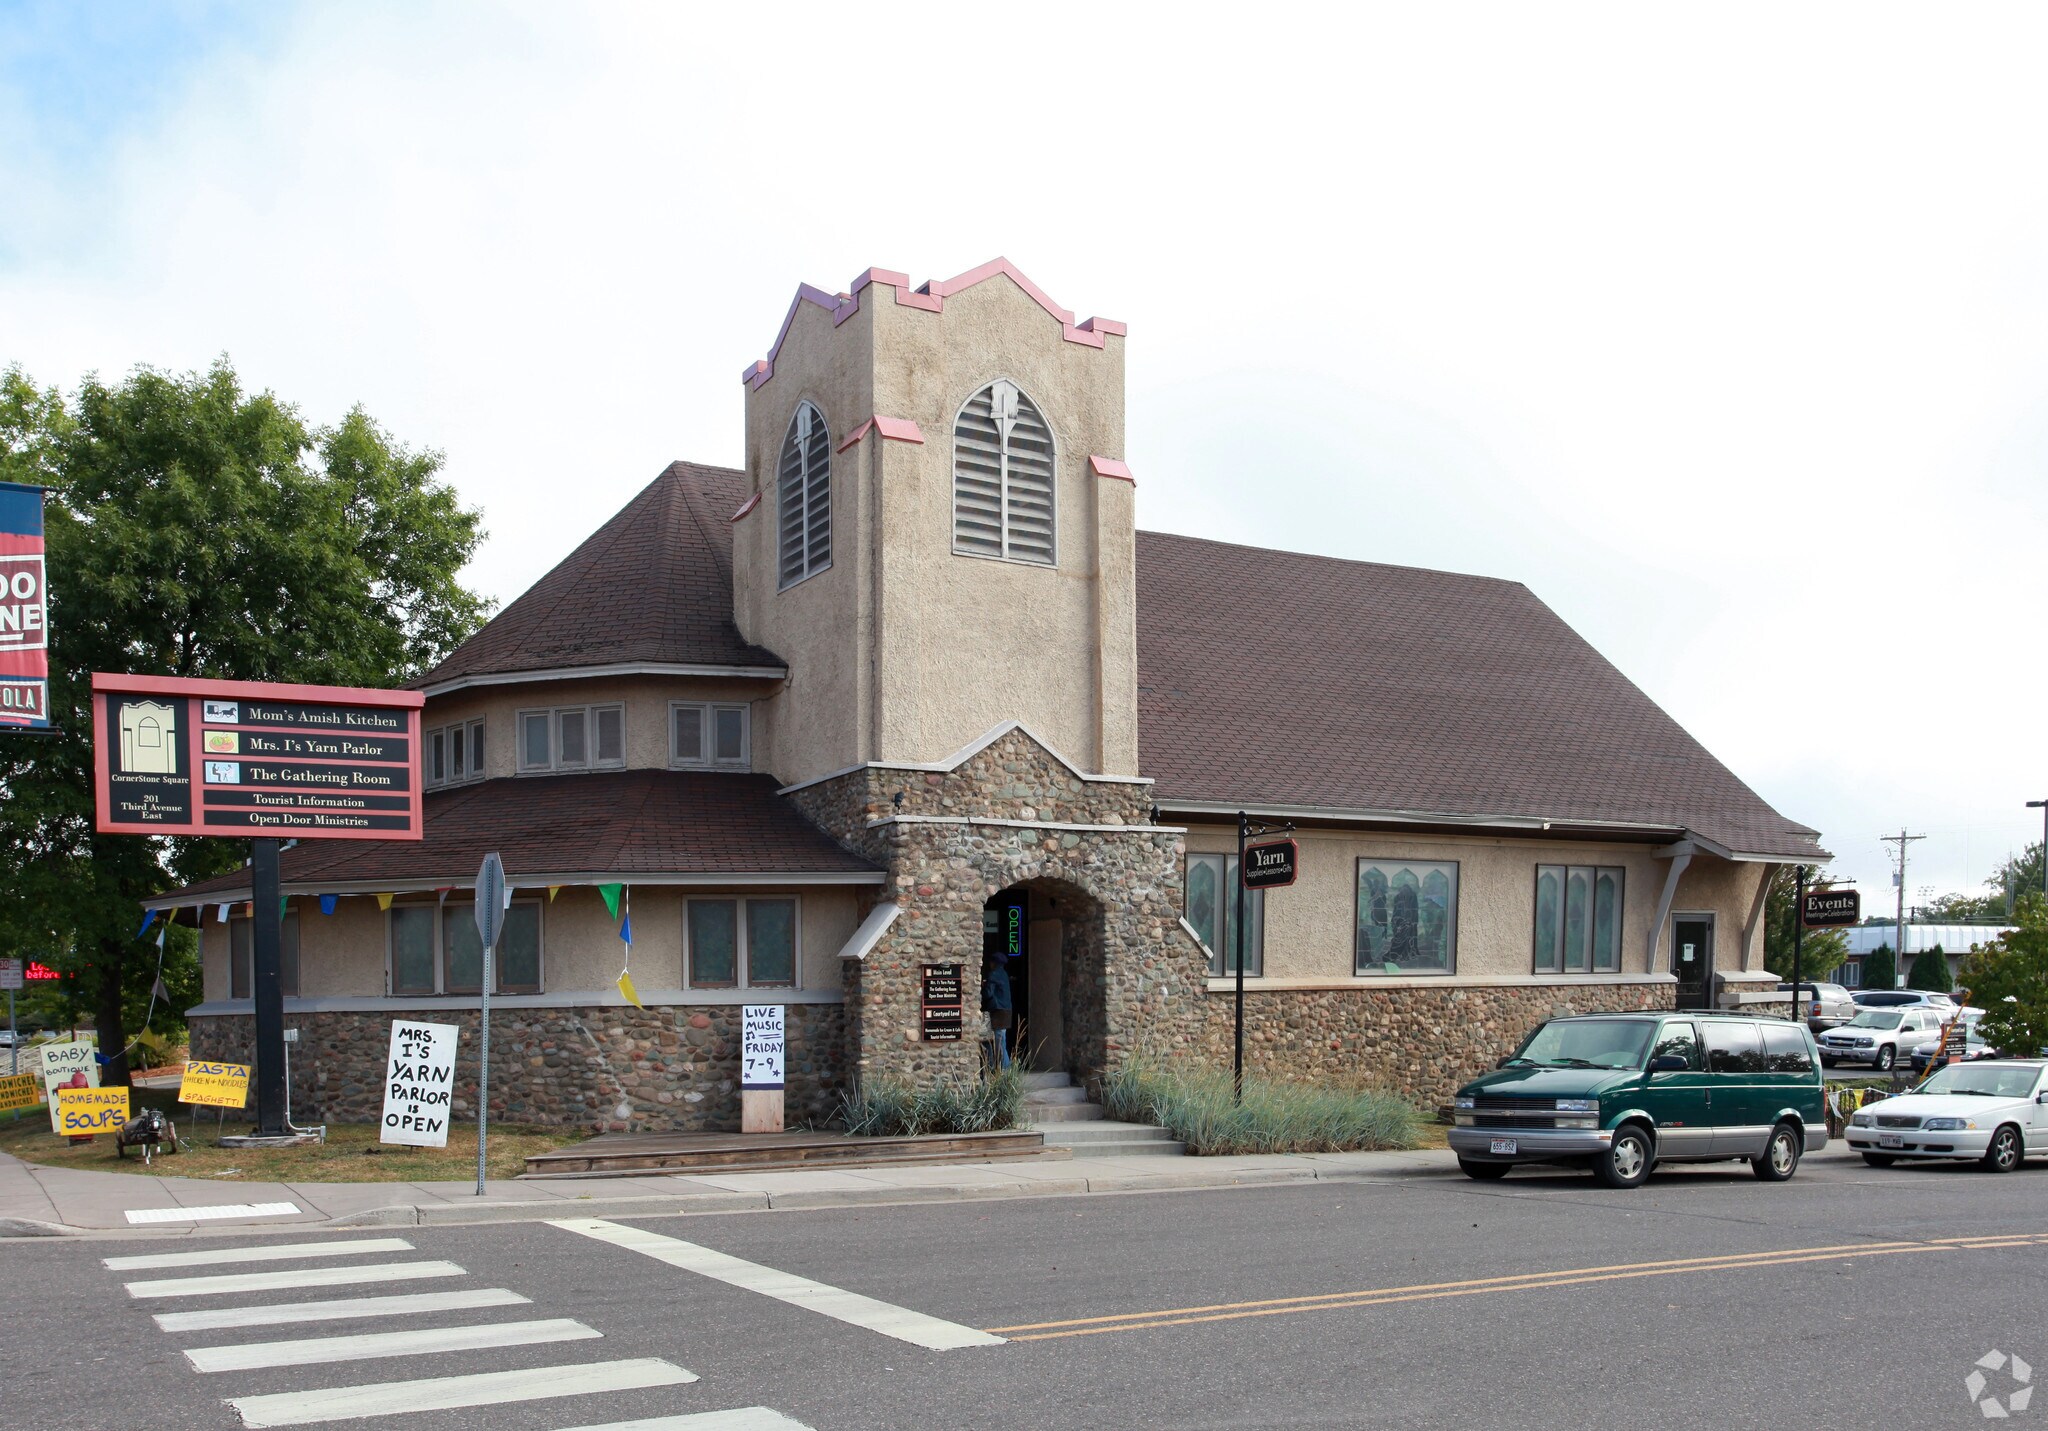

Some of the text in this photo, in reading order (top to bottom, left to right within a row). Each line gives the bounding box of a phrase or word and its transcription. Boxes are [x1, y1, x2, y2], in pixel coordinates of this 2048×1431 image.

[249, 708, 398, 727] Mom's Amish Kitchen
[250, 738, 383, 755] Mrs. I's Yarn Parlor
[111, 774, 189, 785] CornerStone Square
[250, 768, 391, 787] The Gathering Room
[143, 794, 159, 802] 201
[253, 793, 365, 807] Tourist Information
[121, 802, 183, 812] Third Avenue
[142, 811, 162, 819] East
[249, 813, 369, 826] Open Door Ministries
[1254, 850, 1285, 866] Yarn
[1808, 897, 1854, 910] Events
[1008, 908, 1019, 954] OPEN
[745, 1007, 776, 1018] LIVE
[746, 1021, 782, 1031] MUSIC
[398, 1027, 437, 1044] MRS.
[402, 1042, 430, 1059] I'S
[745, 1042, 784, 1054] FRIDAY
[47, 1048, 90, 1063] BABY
[45, 1065, 91, 1076] BOUTIQUE
[187, 1062, 247, 1078] PASTA
[745, 1057, 774, 1070] 7-9
[391, 1059, 450, 1083] YARN
[183, 1076, 211, 1086] CHICKEN
[217, 1078, 248, 1089] NOODLES
[60, 1094, 127, 1104] HOMEMADE
[185, 1092, 240, 1106] SPAGHETTI
[391, 1083, 449, 1106] PARLOR
[408, 1104, 419, 1114] IS
[65, 1109, 125, 1129] SOUPS
[385, 1113, 443, 1133] OPEN
